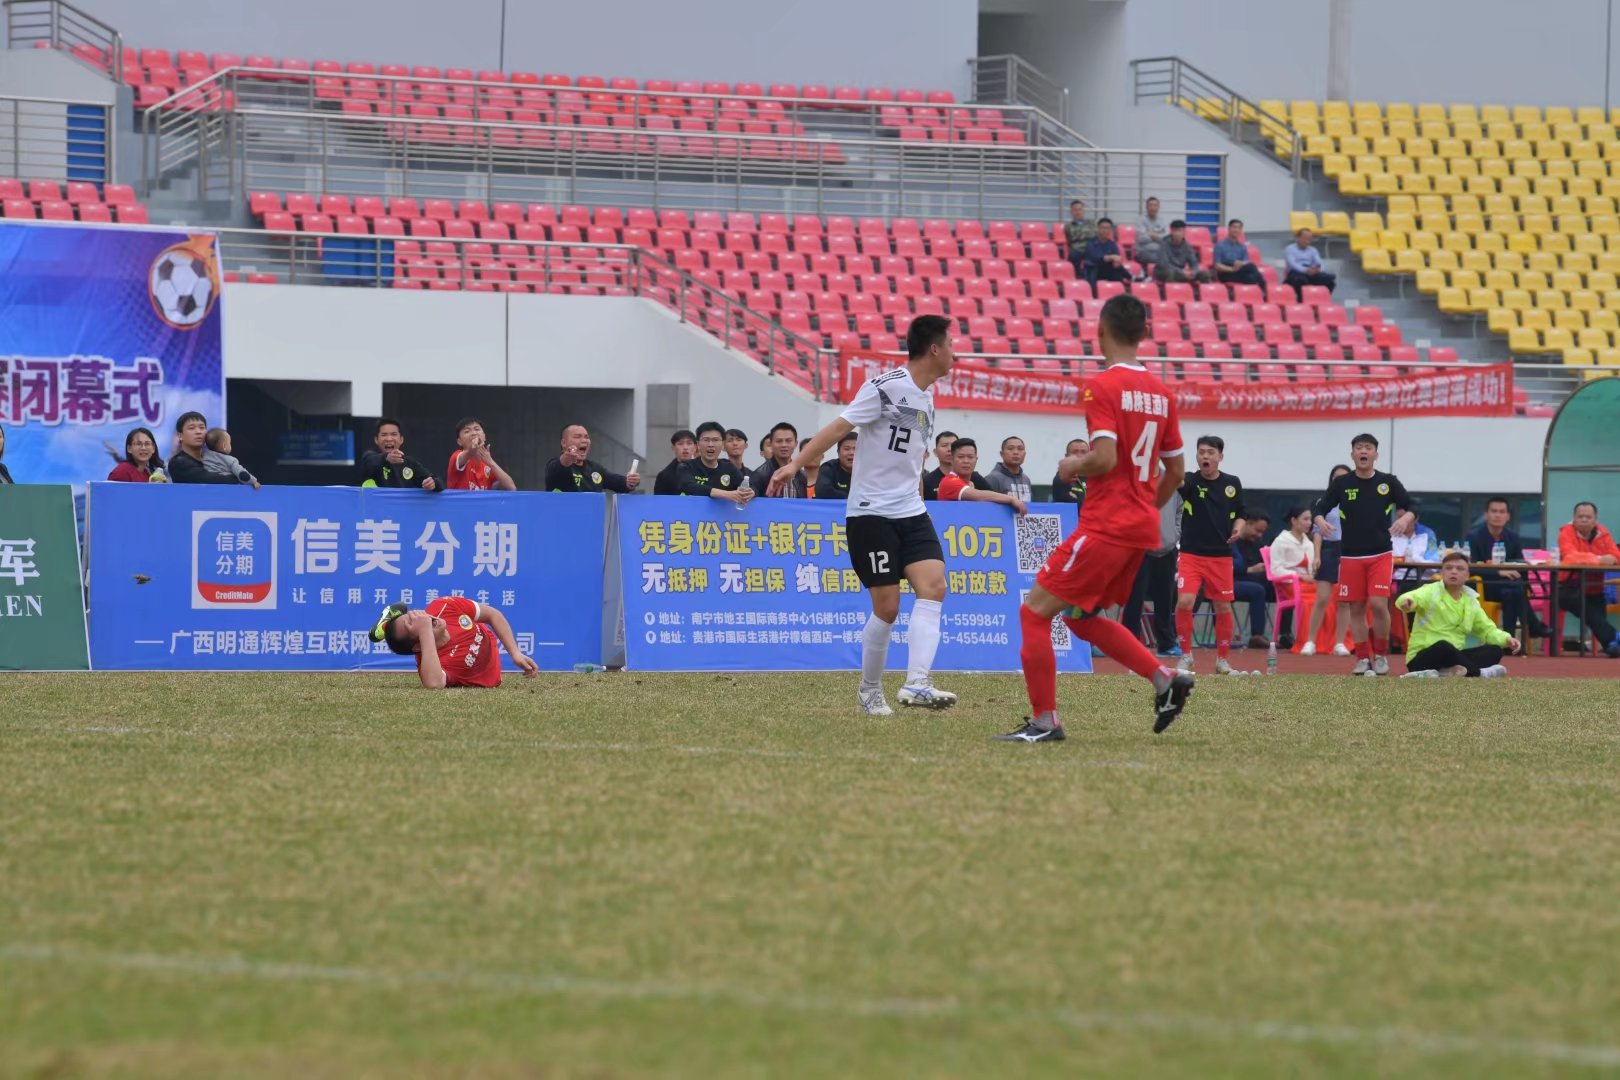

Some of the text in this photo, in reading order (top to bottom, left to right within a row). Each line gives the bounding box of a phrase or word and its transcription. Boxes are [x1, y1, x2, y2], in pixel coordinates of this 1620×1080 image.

[887, 424, 912, 454] 12
[1131, 420, 1158, 483] 4
[215, 530, 254, 552] 信美
[291, 517, 519, 577] 信美分期
[215, 554, 254, 576] 分期
[868, 550, 890, 574] 12
[641, 562, 708, 594] 无抵押
[719, 563, 786, 594] 无担保
[0, 594, 43, 617] EN
[215, 590, 254, 600] CreditMate
